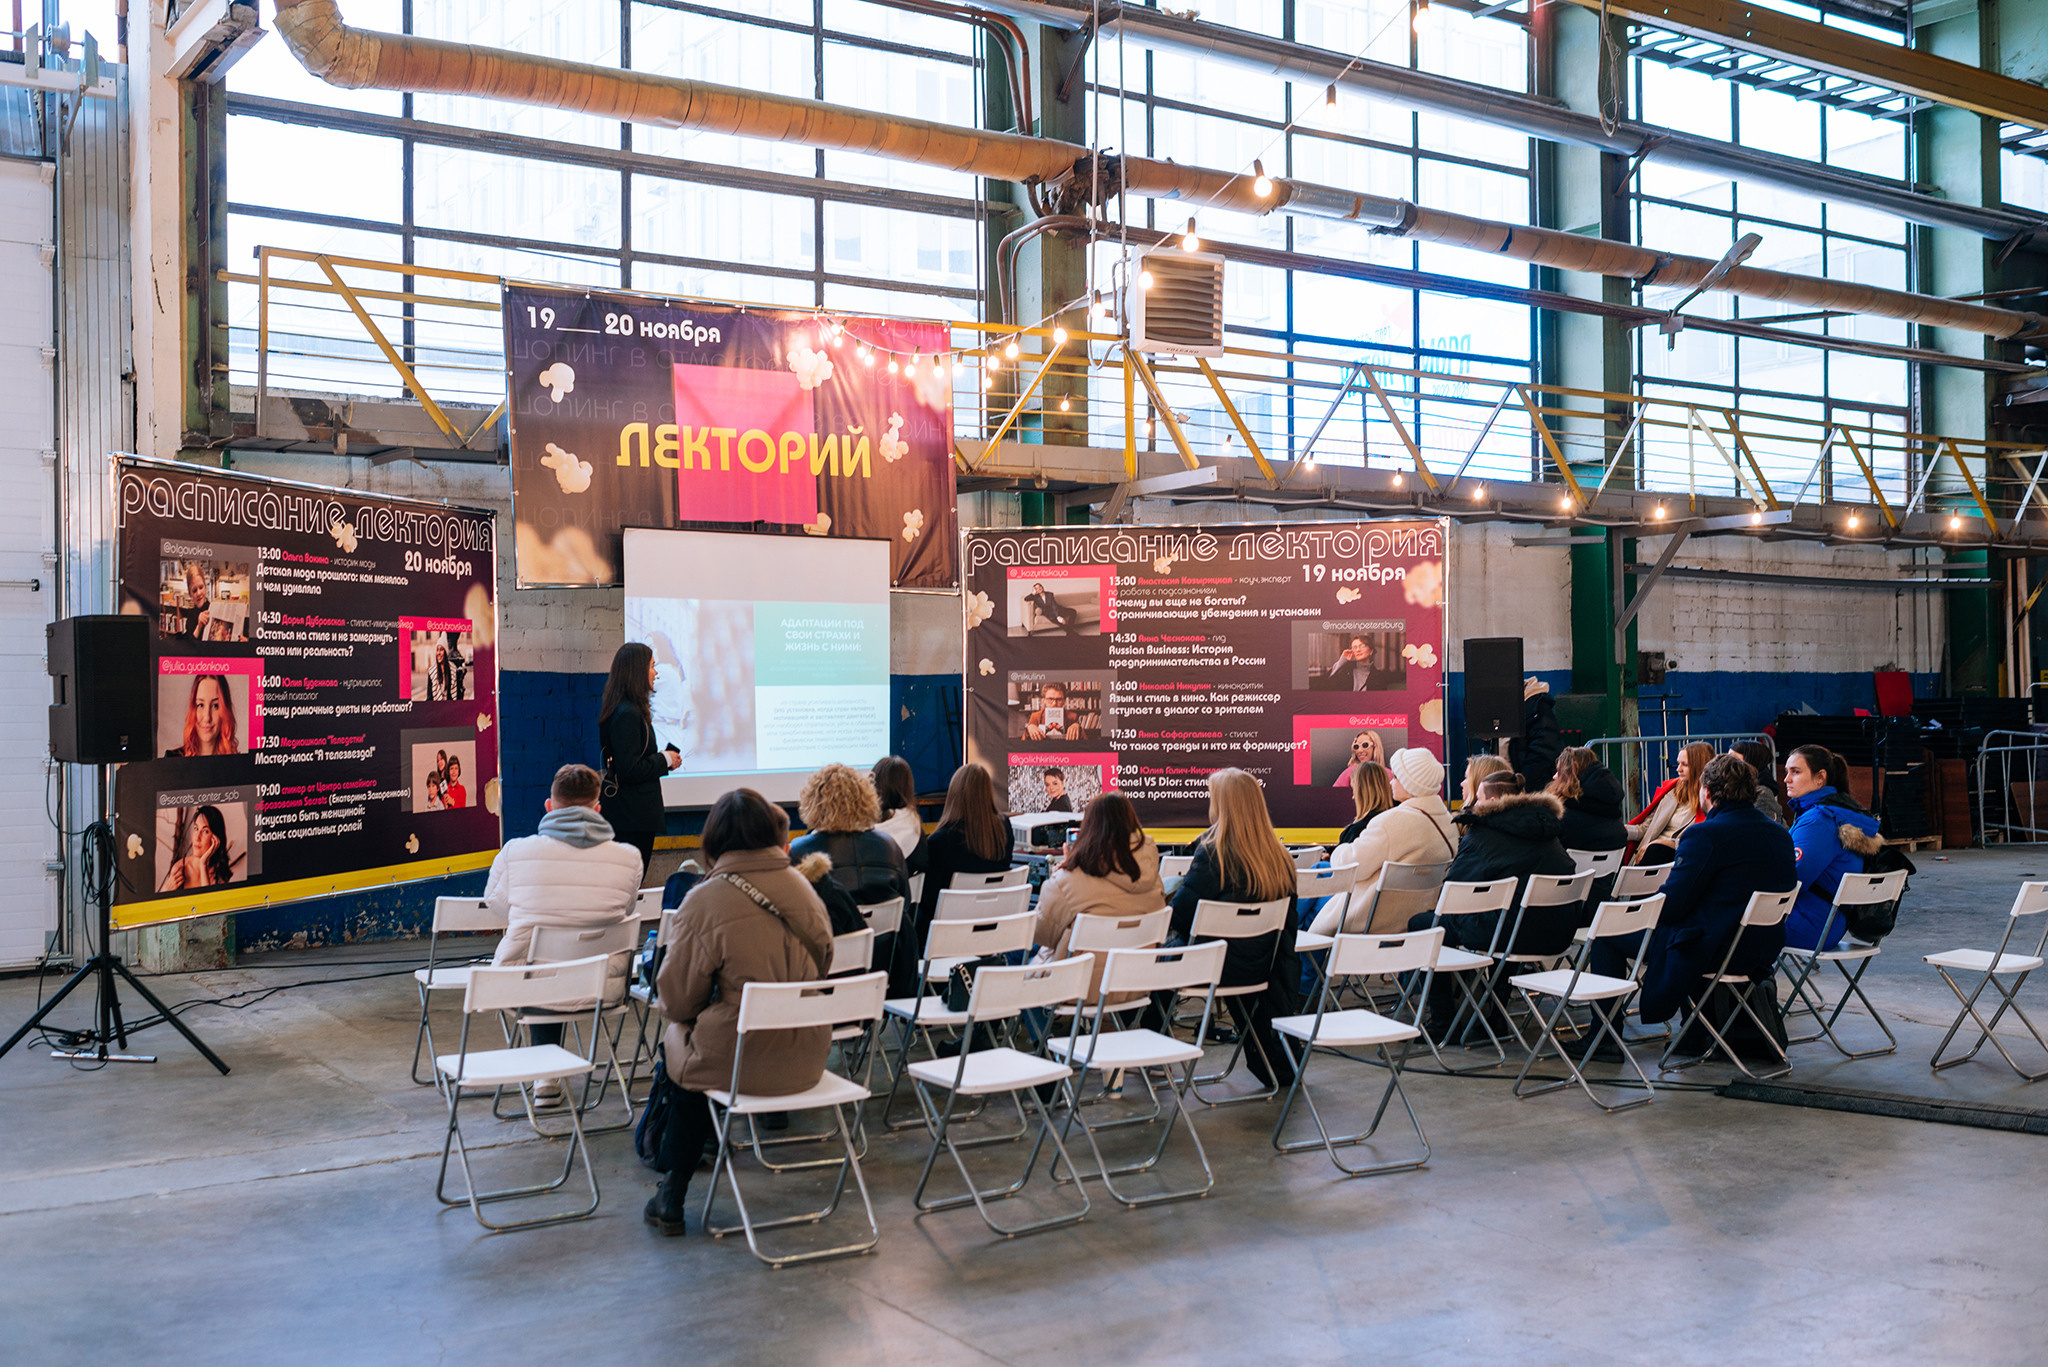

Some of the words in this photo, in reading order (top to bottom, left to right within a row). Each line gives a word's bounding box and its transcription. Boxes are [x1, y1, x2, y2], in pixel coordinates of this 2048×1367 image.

[527, 306, 556, 330] 19
[604, 312, 634, 336] 20
[640, 319, 721, 347] ноября
[616, 422, 872, 478] ЛЕКТОРИЙ
[119, 473, 346, 538] расписание
[355, 506, 493, 560] лектория
[164, 542, 212, 557] @olgavokina
[967, 534, 1218, 576] расписание
[1230, 528, 1442, 568] лектория
[258, 547, 280, 560] 13:00
[282, 551, 303, 562] Ольга
[305, 553, 328, 564] Вокина
[334, 558, 358, 568] историк
[359, 560, 376, 570] моды
[404, 551, 422, 572] 20
[426, 556, 472, 580] ноября
[256, 563, 292, 578] Детская
[293, 569, 316, 581] мода
[317, 570, 358, 582] прошлого:
[360, 574, 373, 583] как
[1010, 568, 1068, 578] @_kozyritskaya
[1303, 564, 1326, 582] 19
[1332, 563, 1406, 585] ноября
[1109, 576, 1136, 585] 13:00
[1138, 577, 1179, 585] Анастасия
[1181, 577, 1232, 586] Козырицкая
[257, 582, 262, 591] и
[264, 583, 281, 592] чем
[282, 585, 321, 596] удивляла
[1120, 587, 1150, 597] работе
[1158, 588, 1217, 597] подсознанием
[1108, 598, 1146, 608] Почему
[1149, 599, 1163, 607] вы
[1165, 599, 1186, 607] еще
[1190, 598, 1202, 606] не
[1204, 596, 1247, 606] богаты?
[257, 611, 281, 624] 14:30
[282, 614, 304, 625] Дарья
[305, 615, 345, 627] Дубровская
[1108, 610, 1198, 621] Ограничивающие
[1201, 607, 1258, 620] убеждения
[1270, 607, 1322, 620] установки
[780, 619, 840, 628] АДАПТАЦИИ
[844, 620, 864, 629] ПОД
[1322, 621, 1404, 630] @madeinpetersburg
[256, 627, 295, 640] Остаться
[296, 632, 307, 640] на
[308, 631, 330, 641] стиле
[332, 632, 337, 641] и
[338, 632, 348, 641] не
[350, 633, 392, 645] замерзнуть
[785, 631, 812, 639] СВОИ
[814, 631, 850, 640] СТРАХИ
[1110, 633, 1136, 642] 14:30
[1138, 634, 1159, 642] Анна
[1161, 634, 1206, 642] Чеснокова
[1212, 635, 1226, 643] гид
[256, 646, 285, 656] сказка
[287, 646, 301, 656] или
[303, 646, 353, 659] реальность?
[785, 643, 819, 651] ЖИЗНЬ
[822, 643, 828, 651] С
[831, 643, 862, 651] НИМИ:
[1109, 645, 1144, 655] Russian
[1147, 645, 1190, 655] Business:
[1192, 645, 1233, 654] История
[162, 660, 229, 673] @julia.gudenkova
[1109, 656, 1220, 668] предпринимательства
[1232, 656, 1265, 665] России
[257, 675, 281, 687] 16:00
[282, 678, 302, 687] Юлия
[304, 678, 338, 689] Гуденкова
[1110, 681, 1138, 691] 16:00
[1139, 682, 1175, 690] Николай
[1177, 682, 1211, 692] Никулин
[256, 691, 287, 701] телесный
[289, 692, 318, 701] психолог
[1110, 693, 1134, 702] Язык
[1144, 694, 1171, 702] стиль
[1181, 694, 1207, 702] кино.
[1210, 693, 1229, 702] Как
[1231, 693, 1280, 704] режиссер
[256, 704, 289, 718] Почему
[291, 706, 334, 718] рамочные
[336, 704, 360, 716] диеты
[361, 704, 371, 712] не
[372, 701, 413, 716] работают?
[1110, 706, 1153, 717] вступает
[1156, 706, 1161, 714] в
[1164, 706, 1199, 717] диалог
[1202, 706, 1212, 714] со
[1215, 705, 1264, 716] зрителем
[1350, 716, 1406, 726] @safari_stylist
[1110, 729, 1136, 739] 17:30
[1161, 730, 1222, 740] Сафаргалиева
[256, 736, 279, 748] 17:30
[281, 737, 326, 749] Медиашкола
[1110, 742, 1127, 750] Что
[1129, 742, 1159, 750] такое
[1162, 742, 1200, 752] тренды
[1243, 740, 1307, 752] формирует?
[255, 751, 313, 766] Мастер-класс
[315, 749, 324, 761] "Я
[1011, 755, 1069, 765] @galichkirillova
[1110, 765, 1138, 774] 19:00
[1140, 766, 1164, 774] Юлия
[256, 783, 280, 796] 19:00
[281, 785, 305, 795] спикер
[307, 784, 315, 792] от
[316, 782, 341, 793] Центра
[343, 778, 377, 789] семейного
[1110, 777, 1142, 786] Chanel
[1144, 778, 1156, 786] VS
[1159, 777, 1182, 786] Dior:
[160, 788, 239, 805] @secrets_center_spb
[255, 797, 302, 812] образования
[304, 795, 327, 806] Secrets
[328, 793, 366, 806] (Екатерина
[255, 814, 297, 828] Искусство
[299, 810, 319, 822] быть
[321, 804, 365, 819] женщиной:
[255, 829, 286, 842] баланс
[288, 826, 336, 839] социальных
[338, 819, 362, 834] ролей
[728, 874, 770, 906] SECRET
